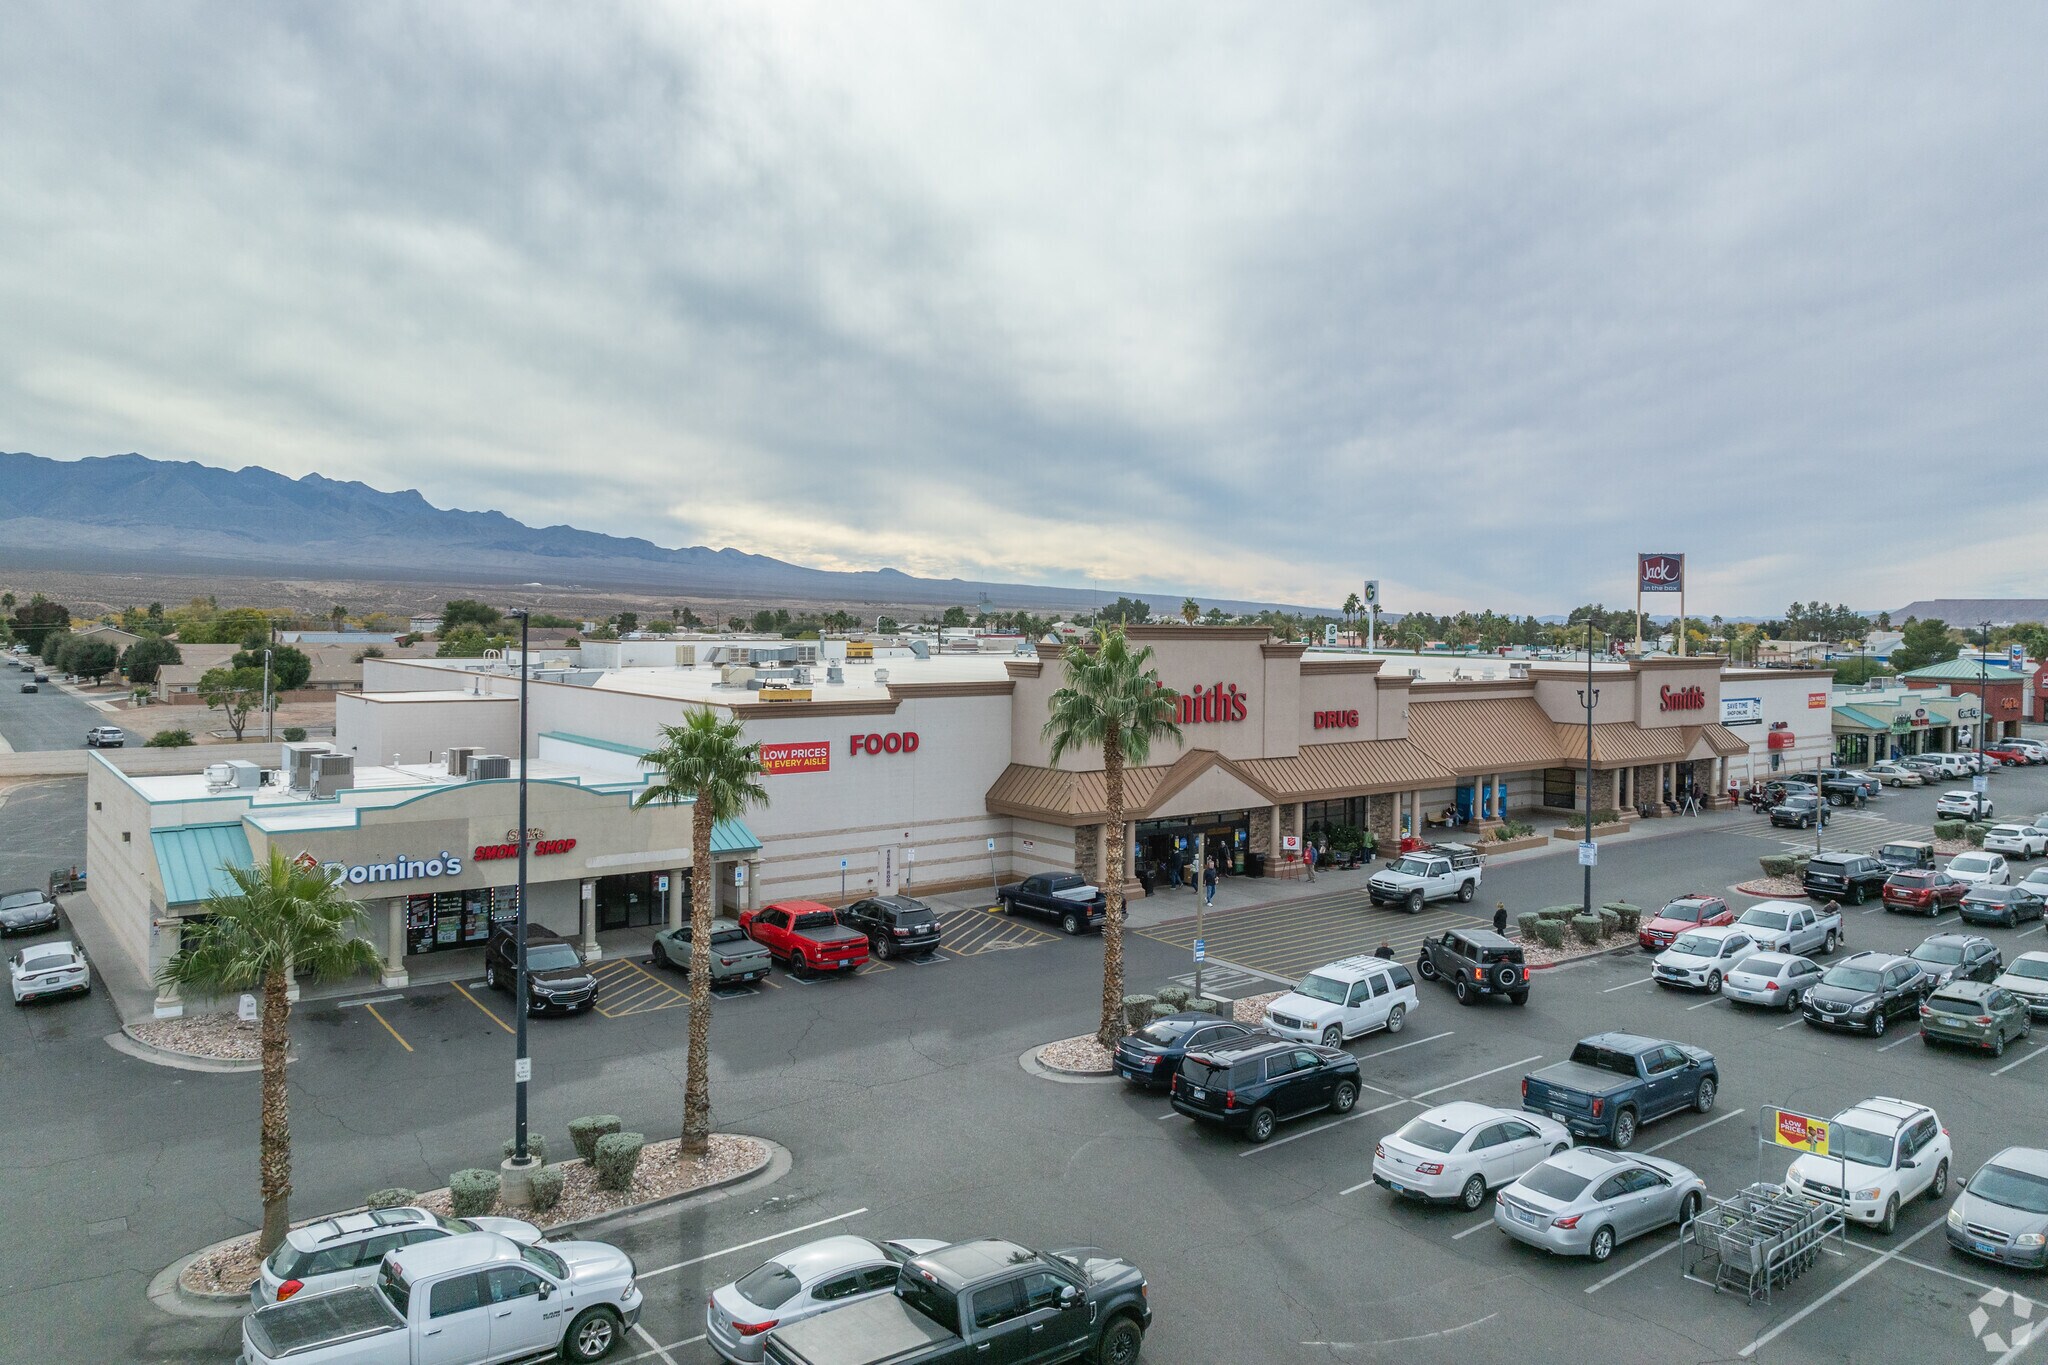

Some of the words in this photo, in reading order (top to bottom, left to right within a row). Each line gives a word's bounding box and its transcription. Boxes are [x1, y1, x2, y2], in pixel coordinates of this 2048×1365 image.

[1642, 559, 1679, 580] Jack
[1150, 680, 1247, 724] mith's
[1660, 685, 1705, 711] Smith's
[1314, 709, 1359, 729] DRUG
[763, 750, 788, 760] LOW
[791, 748, 827, 759] PRICES
[850, 731, 920, 756] FOOD
[774, 759, 801, 768] EVERY
[804, 758, 827, 766] AISLE
[474, 842, 529, 862] SMOK
[535, 839, 577, 857] SHOP
[323, 851, 463, 887] Domino's
[1780, 1123, 1806, 1135] PRICES
[1784, 1119, 1802, 1128] LOW
